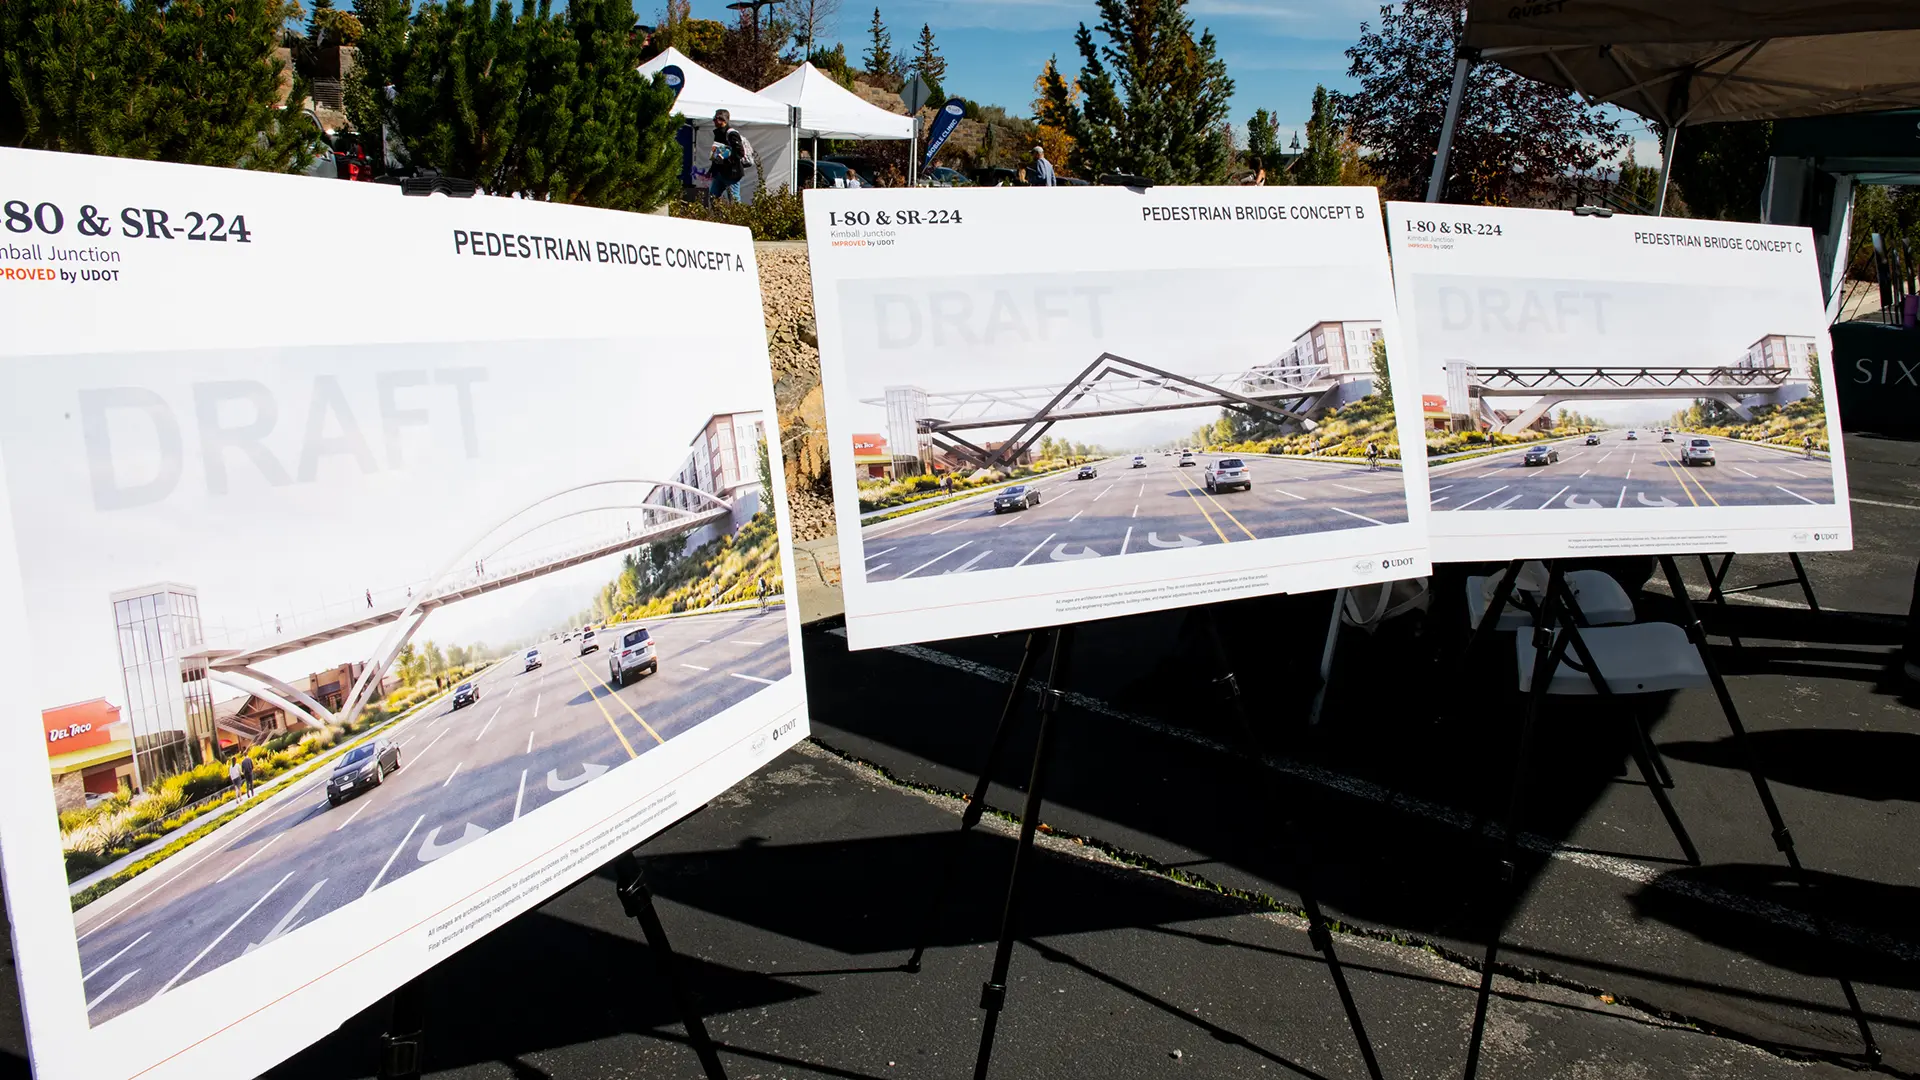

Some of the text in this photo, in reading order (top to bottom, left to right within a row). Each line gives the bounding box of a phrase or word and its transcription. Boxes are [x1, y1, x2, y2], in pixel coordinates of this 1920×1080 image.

[1508, 0, 1567, 20] QUEST
[926, 136, 944, 158] MOBILE
[941, 119, 958, 138] CLINIC
[0, 200, 252, 243] 80 & SR-224
[829, 209, 963, 227] I-80 & SR-224
[1142, 205, 1365, 221] PEDESTRIAN BRIDGE CONCEPT B
[830, 229, 896, 238] Kimball Junction
[1406, 219, 1503, 236] I-80 & SR-224
[453, 229, 746, 273] PEDESTRIAN BRIDGE CONCEPT A
[867, 239, 875, 247] by
[1634, 231, 1803, 254] PEDESTRIAN BRIDGE CONCEPT C
[0, 243, 121, 262] mball Junction
[60, 268, 77, 283] by
[80, 269, 120, 282] UDOT
[872, 286, 1114, 350] DRAFT
[1437, 286, 1614, 335] DRAFT
[1853, 358, 1920, 387] SIX
[77, 366, 490, 513] DRAFT
[1391, 557, 1414, 567] UDOT
[779, 718, 796, 735] UDOT
